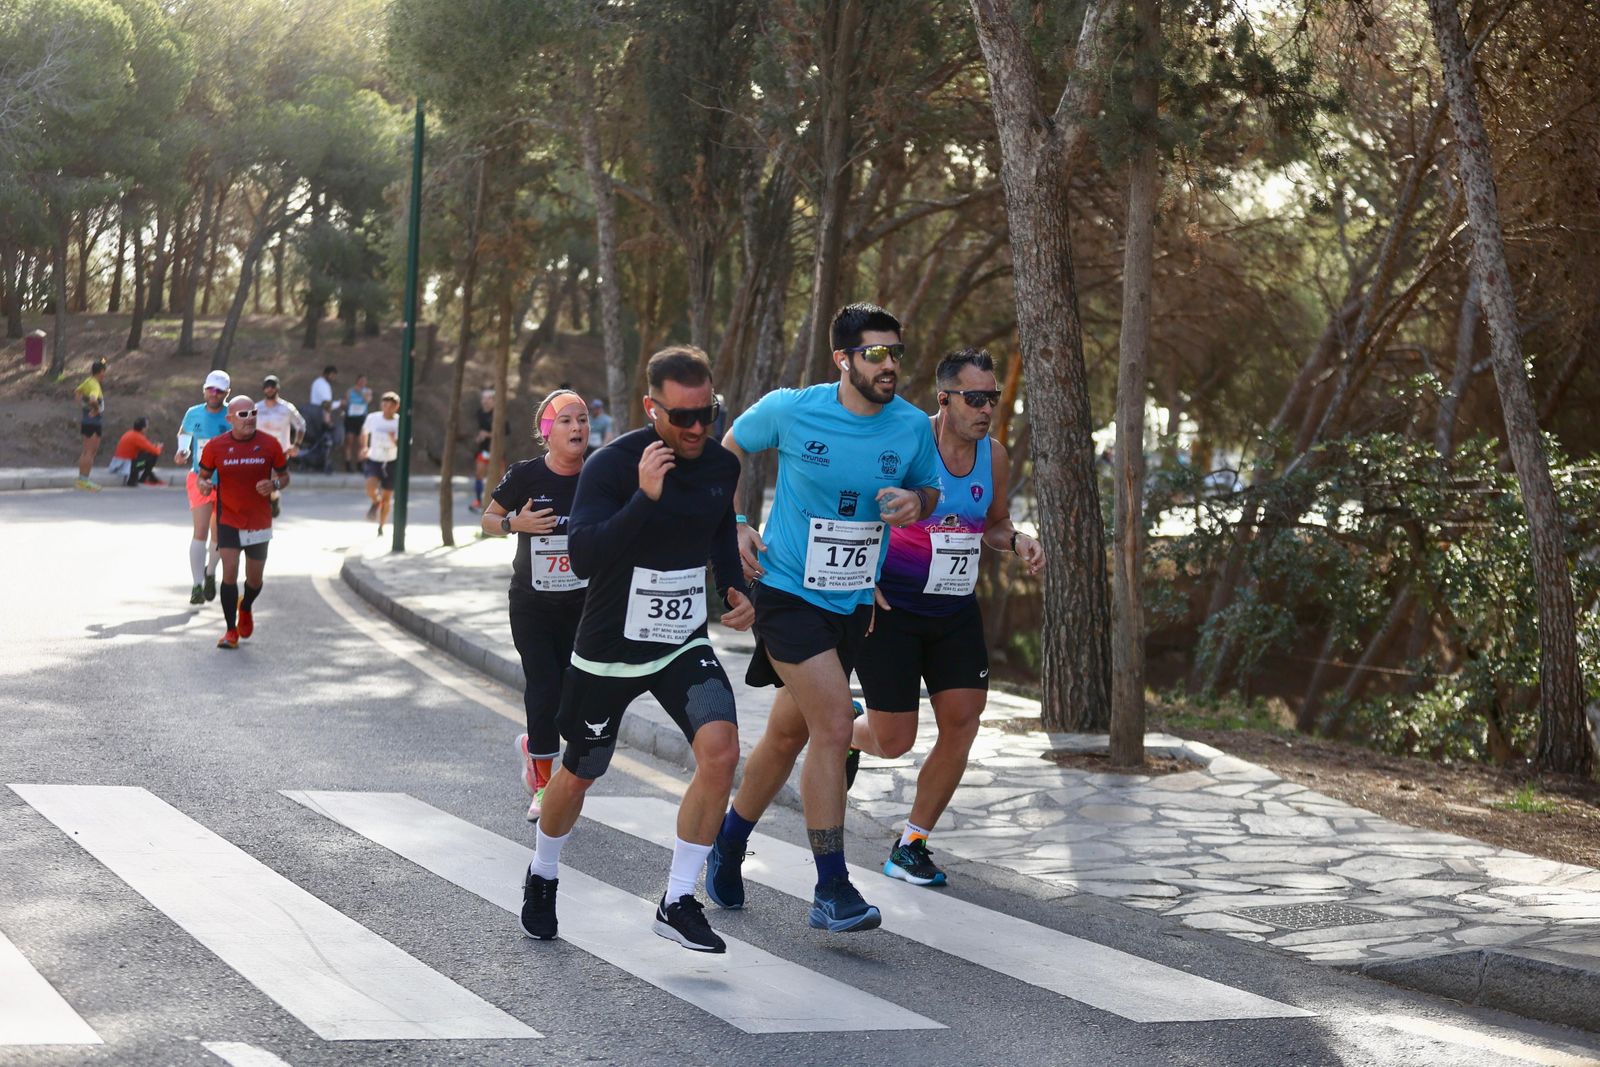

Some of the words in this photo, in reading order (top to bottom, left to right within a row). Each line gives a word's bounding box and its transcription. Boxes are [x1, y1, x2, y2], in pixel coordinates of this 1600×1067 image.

[240, 457, 266, 465] PEDRO
[801, 453, 831, 464] HYUNDAI
[826, 546, 868, 568] 176
[949, 556, 968, 575] 72
[647, 597, 693, 621] 382
